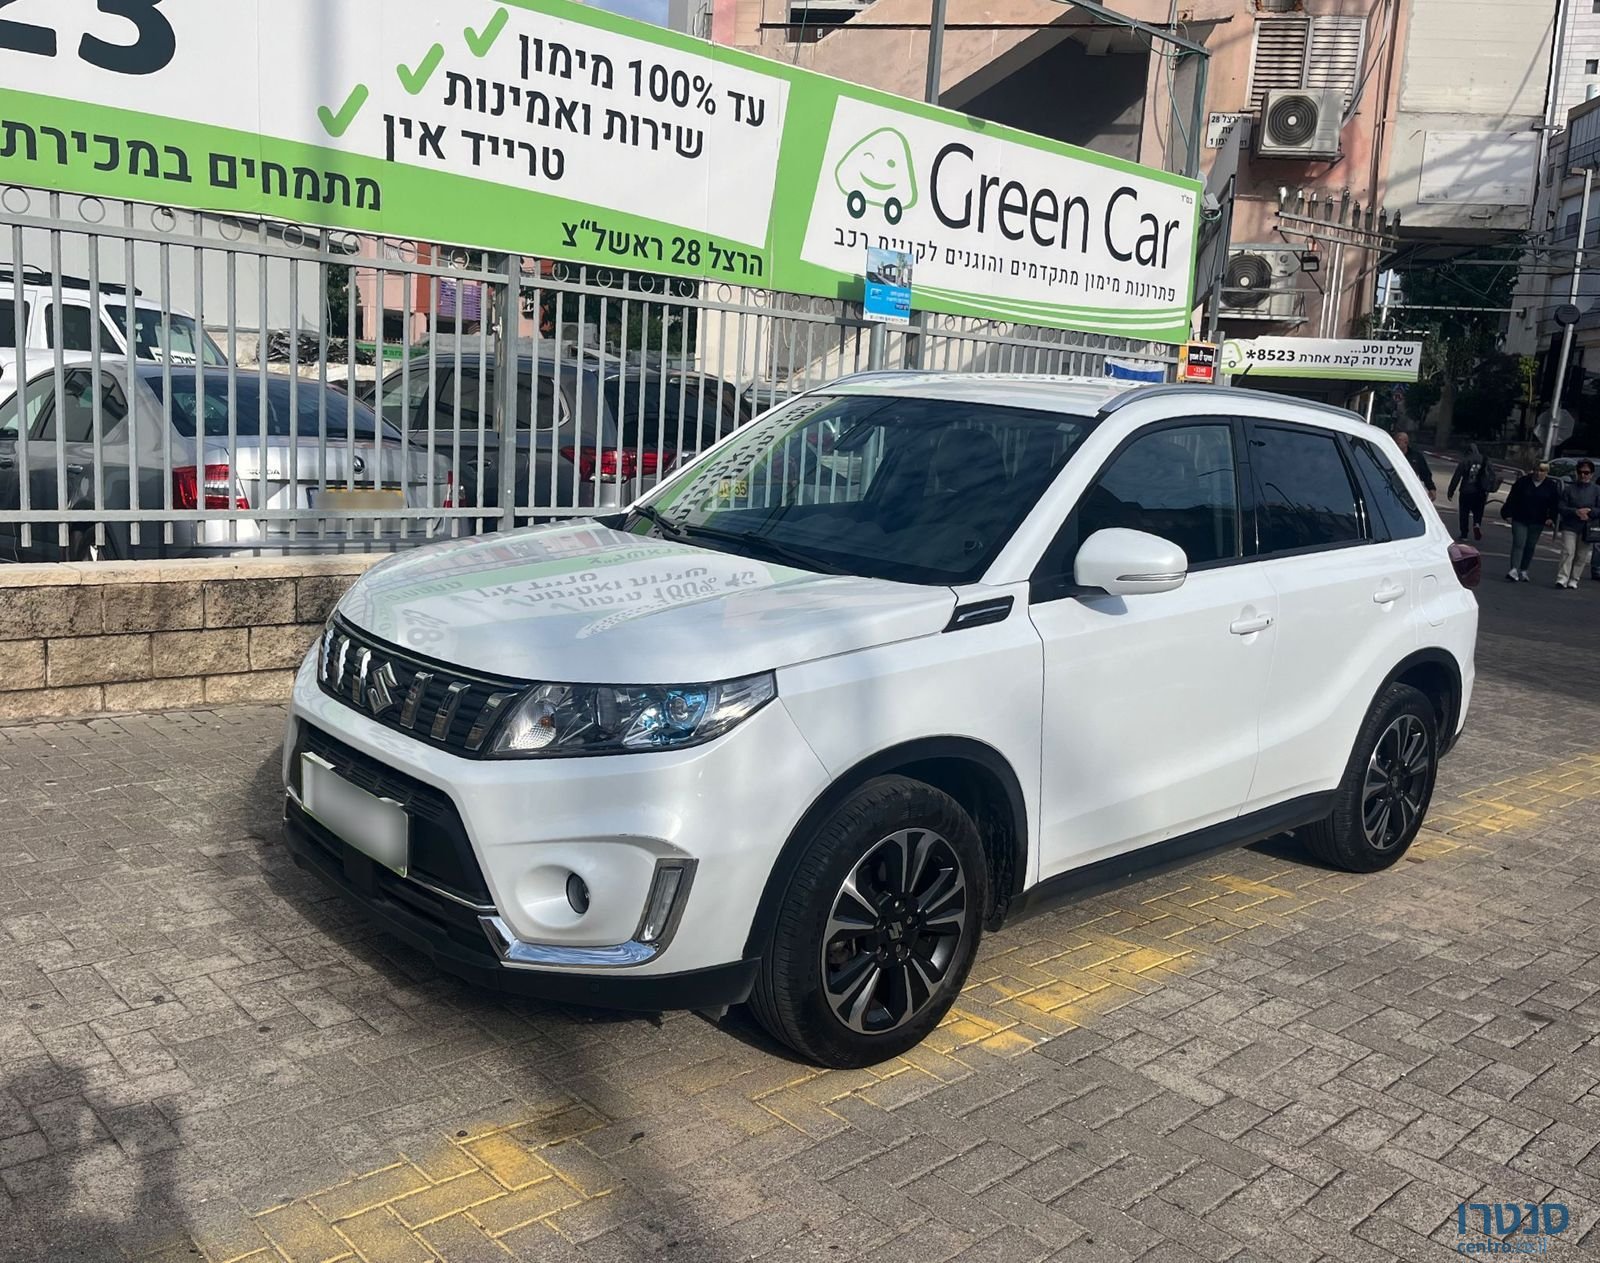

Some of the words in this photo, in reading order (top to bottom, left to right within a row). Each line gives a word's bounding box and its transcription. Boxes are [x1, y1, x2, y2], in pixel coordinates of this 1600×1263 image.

[519, 33, 614, 90] מימון
[628, 59, 717, 116] 100%
[443, 71, 591, 136] ואמינות
[727, 90, 766, 127] עד
[1211, 115, 1221, 123] 28
[383, 114, 447, 162] אין
[602, 108, 704, 160] שירות
[1, 119, 193, 183] במכירת
[461, 130, 565, 181] טרייד
[209, 152, 382, 212] מתמחים
[929, 142, 1090, 254] Green
[1104, 186, 1180, 270] Car
[671, 236, 702, 267] 28
[834, 227, 869, 251] רכב
[708, 241, 763, 277] הרצל
[945, 248, 1003, 274] והוגנים
[1010, 259, 1079, 287] מתקדמים
[1084, 272, 1121, 293] מימון
[1125, 279, 1176, 303] פתרונות
[1298, 352, 1331, 363] אחרת
[1333, 353, 1360, 368] קצת
[1361, 355, 1376, 366] זה
[1379, 355, 1413, 367] אצלנו
[1386, 344, 1415, 356] שלם
